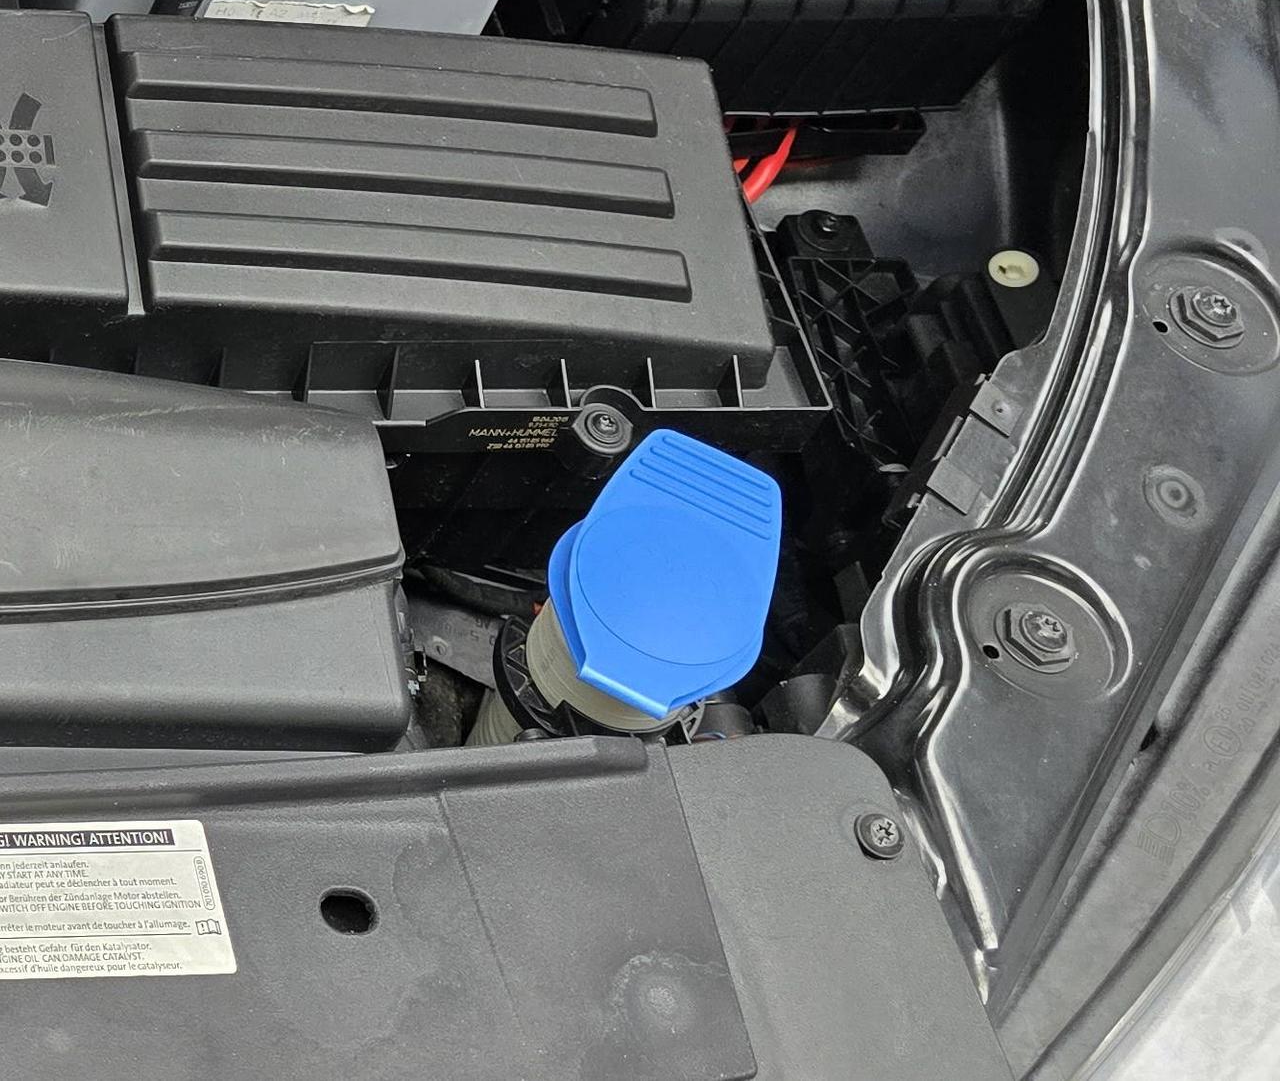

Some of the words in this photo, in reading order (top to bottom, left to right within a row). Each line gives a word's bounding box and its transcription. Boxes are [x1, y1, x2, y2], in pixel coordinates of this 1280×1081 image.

[468, 428, 559, 437] MANN+HUMMEL
[13, 833, 85, 847] WARNING!
[89, 831, 169, 845] ATTENTION!
[12, 861, 48, 871] jederzeit
[50, 860, 89, 869] anlaufen.
[7, 871, 32, 879] START
[34, 870, 45, 879] AT
[46, 870, 63, 878] ANY
[35, 880, 55, 890] peut
[67, 877, 111, 887] déclencher
[119, 878, 138, 886] tout
[139, 877, 177, 886] moment.
[9, 894, 47, 903] Berühren
[48, 893, 61, 902] der
[64, 892, 112, 903] Zündanlage
[113, 892, 140, 900] Motor
[141, 891, 181, 899] abstellen.
[30, 904, 45, 912] OFF
[47, 902, 80, 911] ENGINE
[82, 901, 113, 910] BEFORE
[115, 901, 161, 910] TOUCHING
[162, 900, 201, 909] IGNITION
[25, 923, 34, 931] le
[34, 922, 66, 931] moteur
[67, 922, 91, 930] avant
[92, 921, 103, 930] de
[103, 921, 137, 929] toucher
[144, 920, 190, 930] l'allumage.
[4, 945, 37, 953] besteht
[38, 944, 67, 952] Gefahr
[71, 943, 83, 952] für
[85, 943, 101, 951] den
[102, 942, 152, 952] Katalysator.
[24, 954, 39, 963] OIL
[42, 954, 60, 962] CAN
[61, 953, 101, 962] DAMAGE
[102, 952, 145, 961] CATALYST.
[30, 964, 59, 972] d'huile
[60, 963, 105, 974] dangereux
[107, 964, 127, 972] pour
[128, 962, 137, 970] le
[137, 962, 183, 972] catalyseur.
